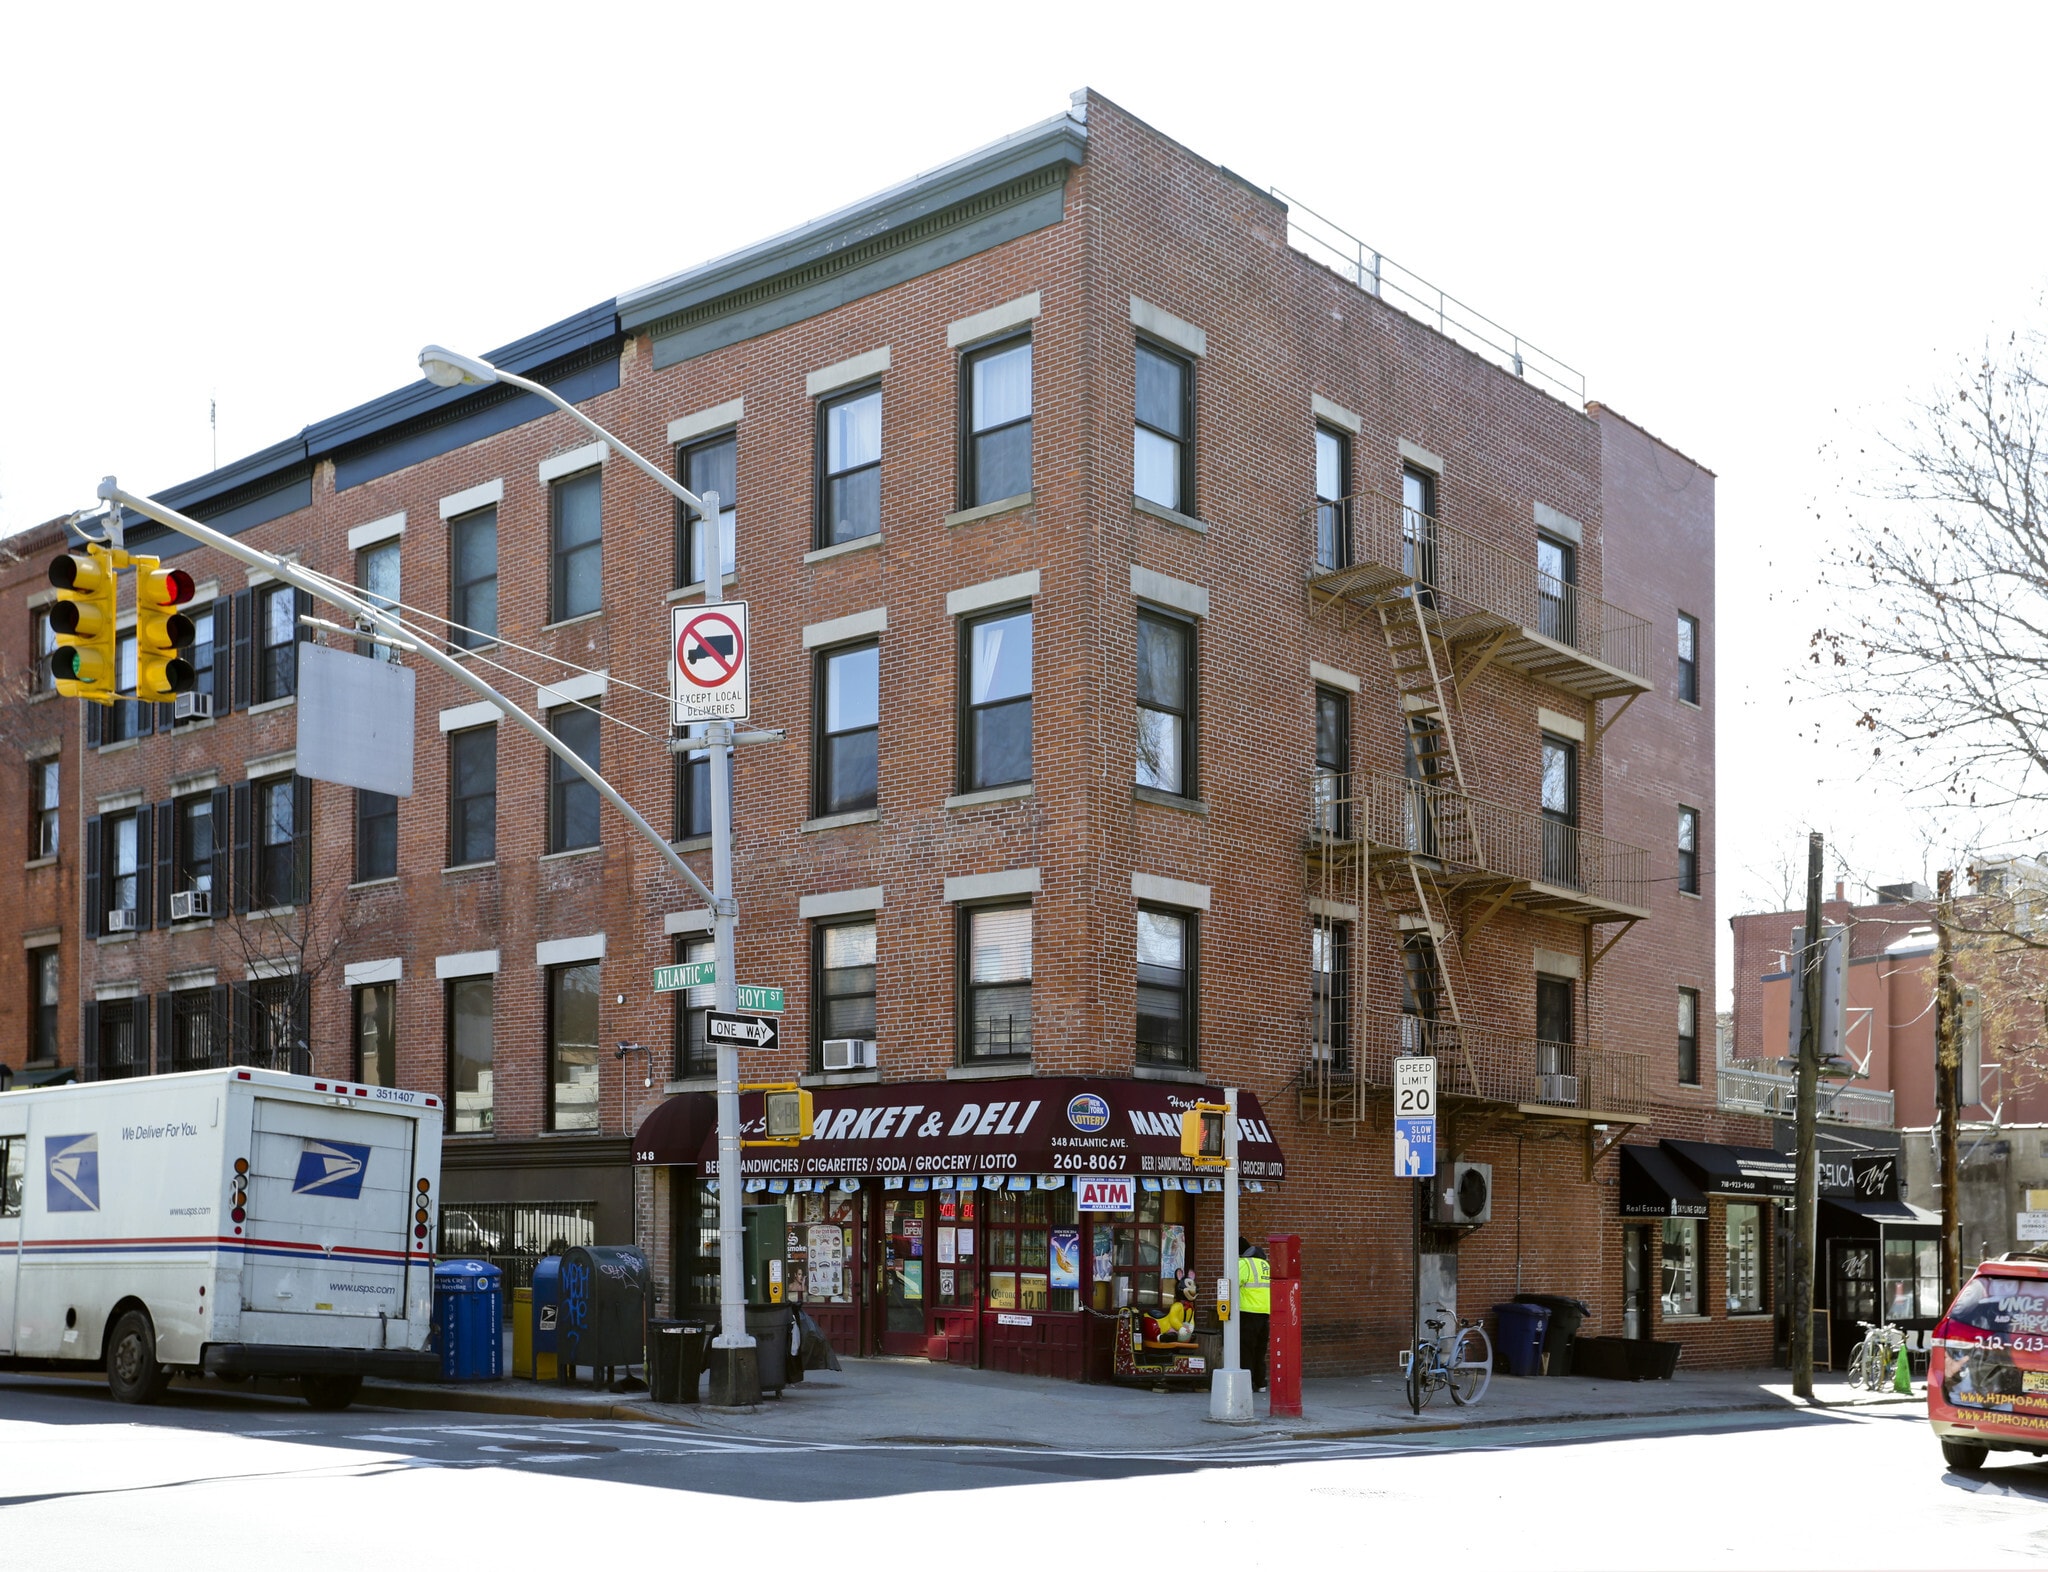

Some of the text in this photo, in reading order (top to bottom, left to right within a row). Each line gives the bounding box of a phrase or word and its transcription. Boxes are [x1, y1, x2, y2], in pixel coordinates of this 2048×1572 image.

[680, 690, 742, 704] EXCEPT LOCAL
[687, 703, 735, 717] DELIVERIES
[657, 963, 714, 989] ATLANTIC AV
[738, 988, 780, 1009] HOYT ST
[716, 1022, 768, 1039] ONE WAY
[1399, 1063, 1432, 1073] SPEED
[1402, 1076, 1428, 1086] LIMIT
[376, 1088, 415, 1102] 3511407
[1400, 1089, 1430, 1111] 20
[1090, 1099, 1101, 1107] NEW
[801, 1101, 1042, 1140] ARKET & DELI
[1071, 1114, 1106, 1126] LOTTERY
[122, 1122, 198, 1141] We Deliver For You.
[1411, 1125, 1432, 1134] SLOW
[1051, 1137, 1129, 1148] 348 ATLANTIC AVE.
[1411, 1135, 1432, 1143] ZONE
[636, 1151, 655, 1162] 348
[740, 1158, 799, 1173] ANDWICHES
[807, 1157, 868, 1173] CIGARETTES
[876, 1156, 907, 1171] SODA
[915, 1154, 972, 1171] GROCERY
[980, 1153, 1017, 1169] LOTTO
[1053, 1153, 1127, 1170] 260-8067
[1141, 1155, 1156, 1171] BEER
[1158, 1156, 1192, 1173] SANDWICHES
[1242, 1160, 1266, 1176] GROCERY
[1268, 1162, 1283, 1177] LOTTO
[1082, 1184, 1128, 1204] ATM
[169, 1207, 211, 1218] www.usps.com
[1625, 1204, 1707, 1215] Real Estate SKYLINE GROUP
[904, 1227, 922, 1236] OPEN
[329, 1282, 395, 1295] www.usps.com
[1998, 1296, 2045, 1313] UNCLE
[2009, 1322, 2038, 1333] THE
